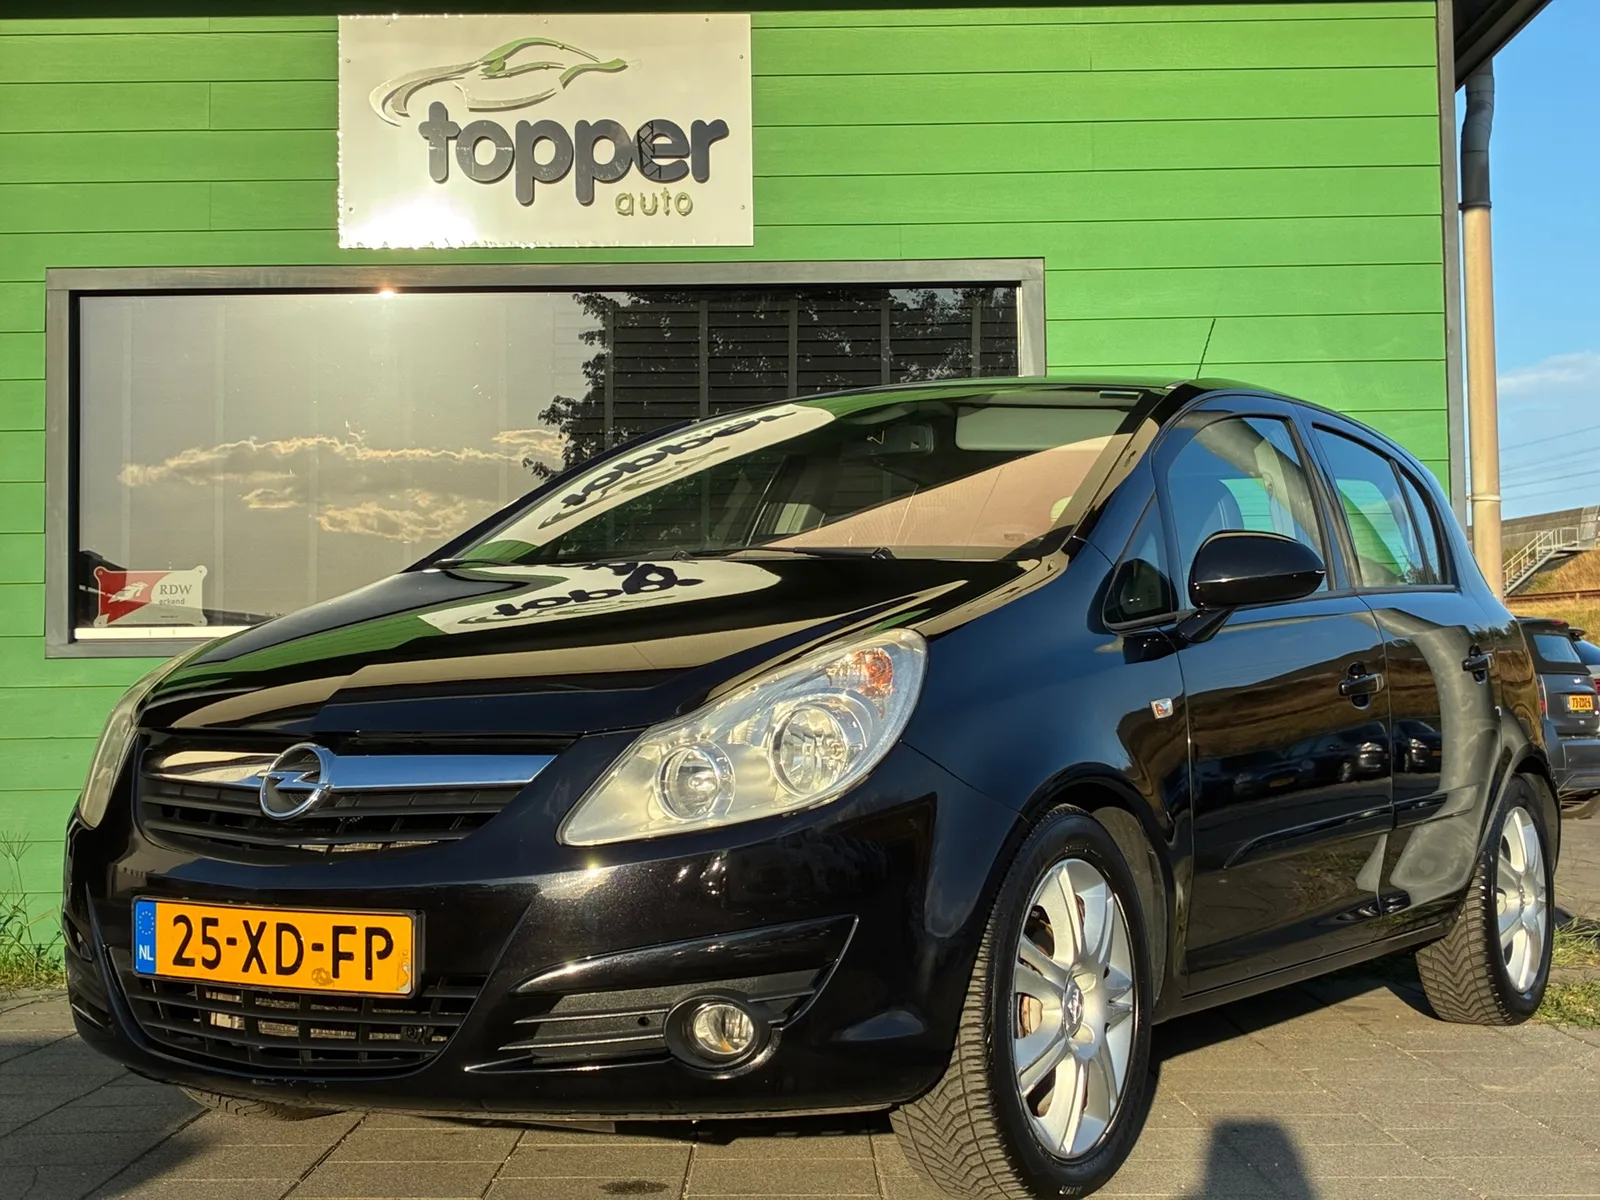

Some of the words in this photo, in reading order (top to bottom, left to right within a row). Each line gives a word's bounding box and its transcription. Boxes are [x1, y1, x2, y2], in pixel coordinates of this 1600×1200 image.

[418, 101, 730, 206] topper
[615, 187, 694, 216] auto
[159, 584, 193, 595] RDW
[139, 945, 154, 961] NL
[172, 914, 394, 980] 25-XD-FP
